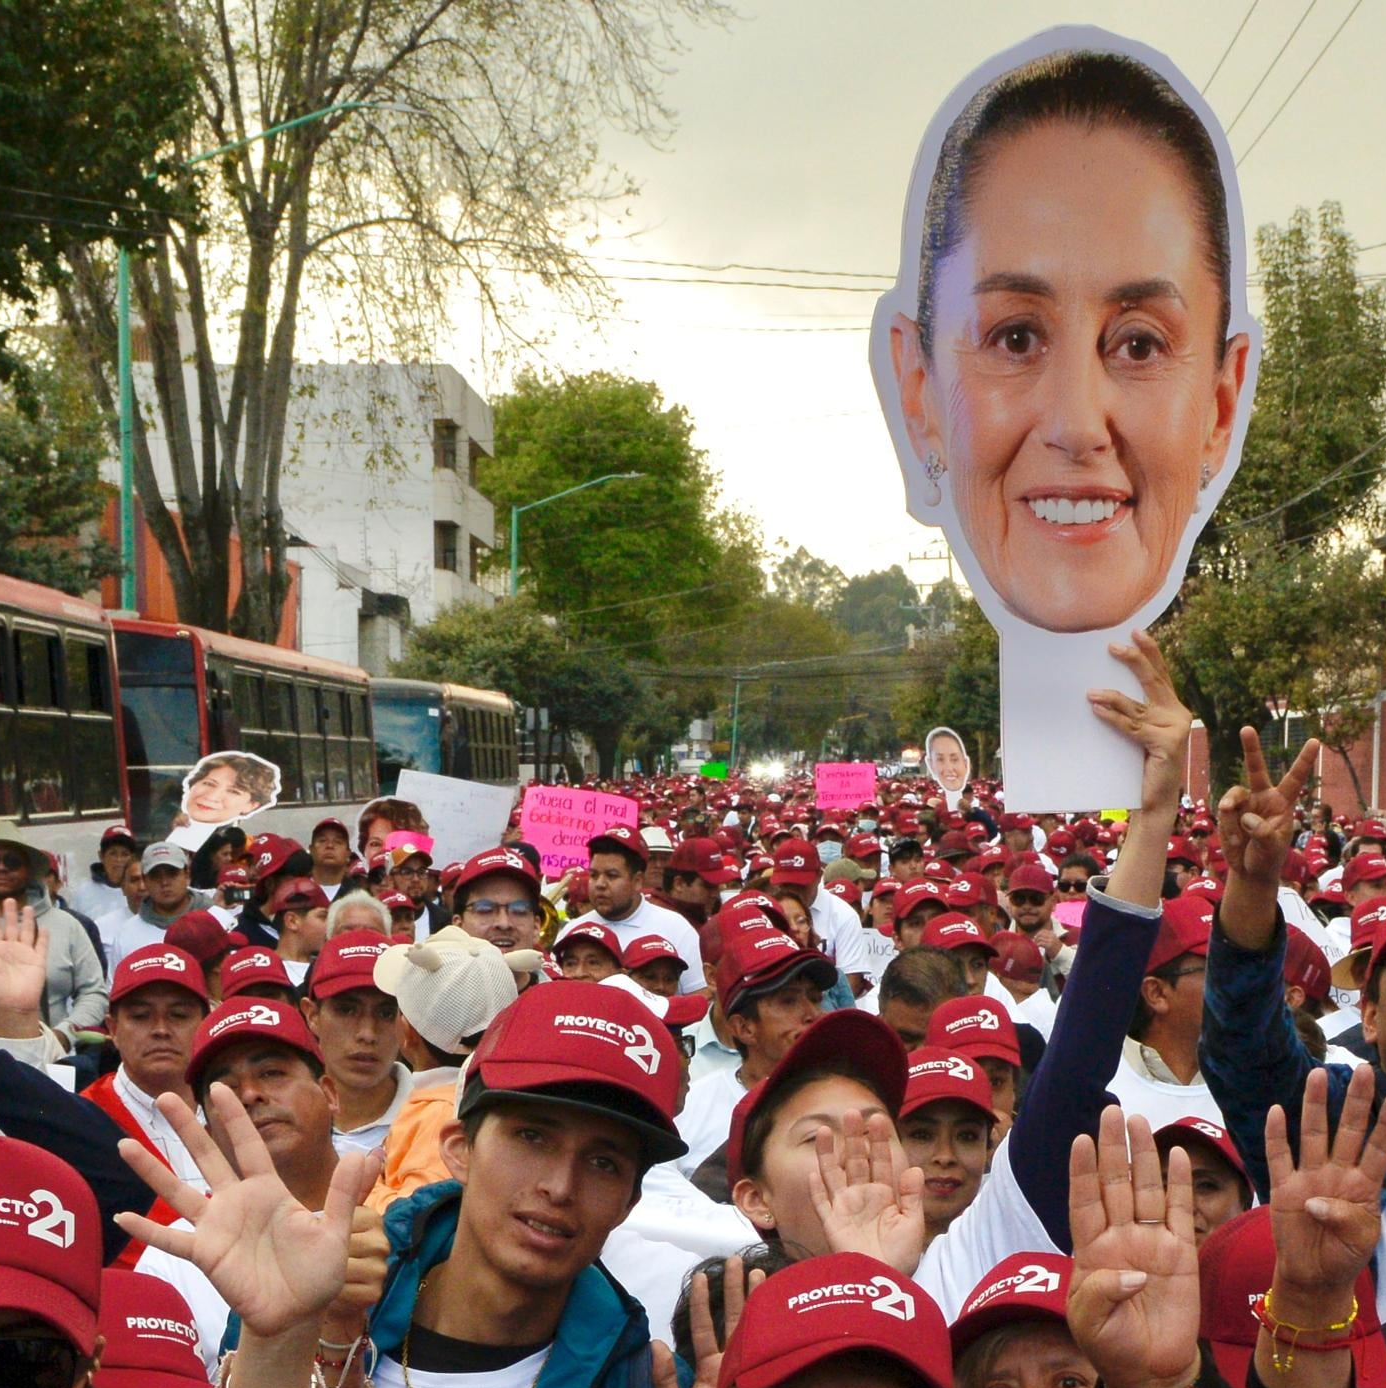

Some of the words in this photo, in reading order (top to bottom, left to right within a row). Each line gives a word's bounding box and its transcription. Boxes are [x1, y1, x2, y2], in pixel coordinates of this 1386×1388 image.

[529, 808, 595, 831] Gobierno
[963, 921, 978, 935] 21
[339, 946, 383, 956] PROYECTO
[756, 935, 789, 949] PROYECTO
[163, 953, 185, 972] 21
[254, 953, 270, 967] 21
[210, 1011, 256, 1036] PROYECTO
[251, 1006, 280, 1026] 21
[946, 1016, 984, 1033] PROYECTO
[978, 1009, 999, 1030] 21
[554, 1015, 636, 1044] PROYECTO
[625, 1024, 661, 1075] 21
[909, 1061, 954, 1077] PROYECTO
[948, 1057, 973, 1081] 21
[27, 1189, 75, 1249] 21
[787, 1282, 881, 1311] PROYECTO
[871, 1276, 915, 1322] 21
[966, 1276, 1025, 1314] PROYECTO
[1014, 1264, 1061, 1294] 21
[125, 1315, 197, 1342] PROYECTO
